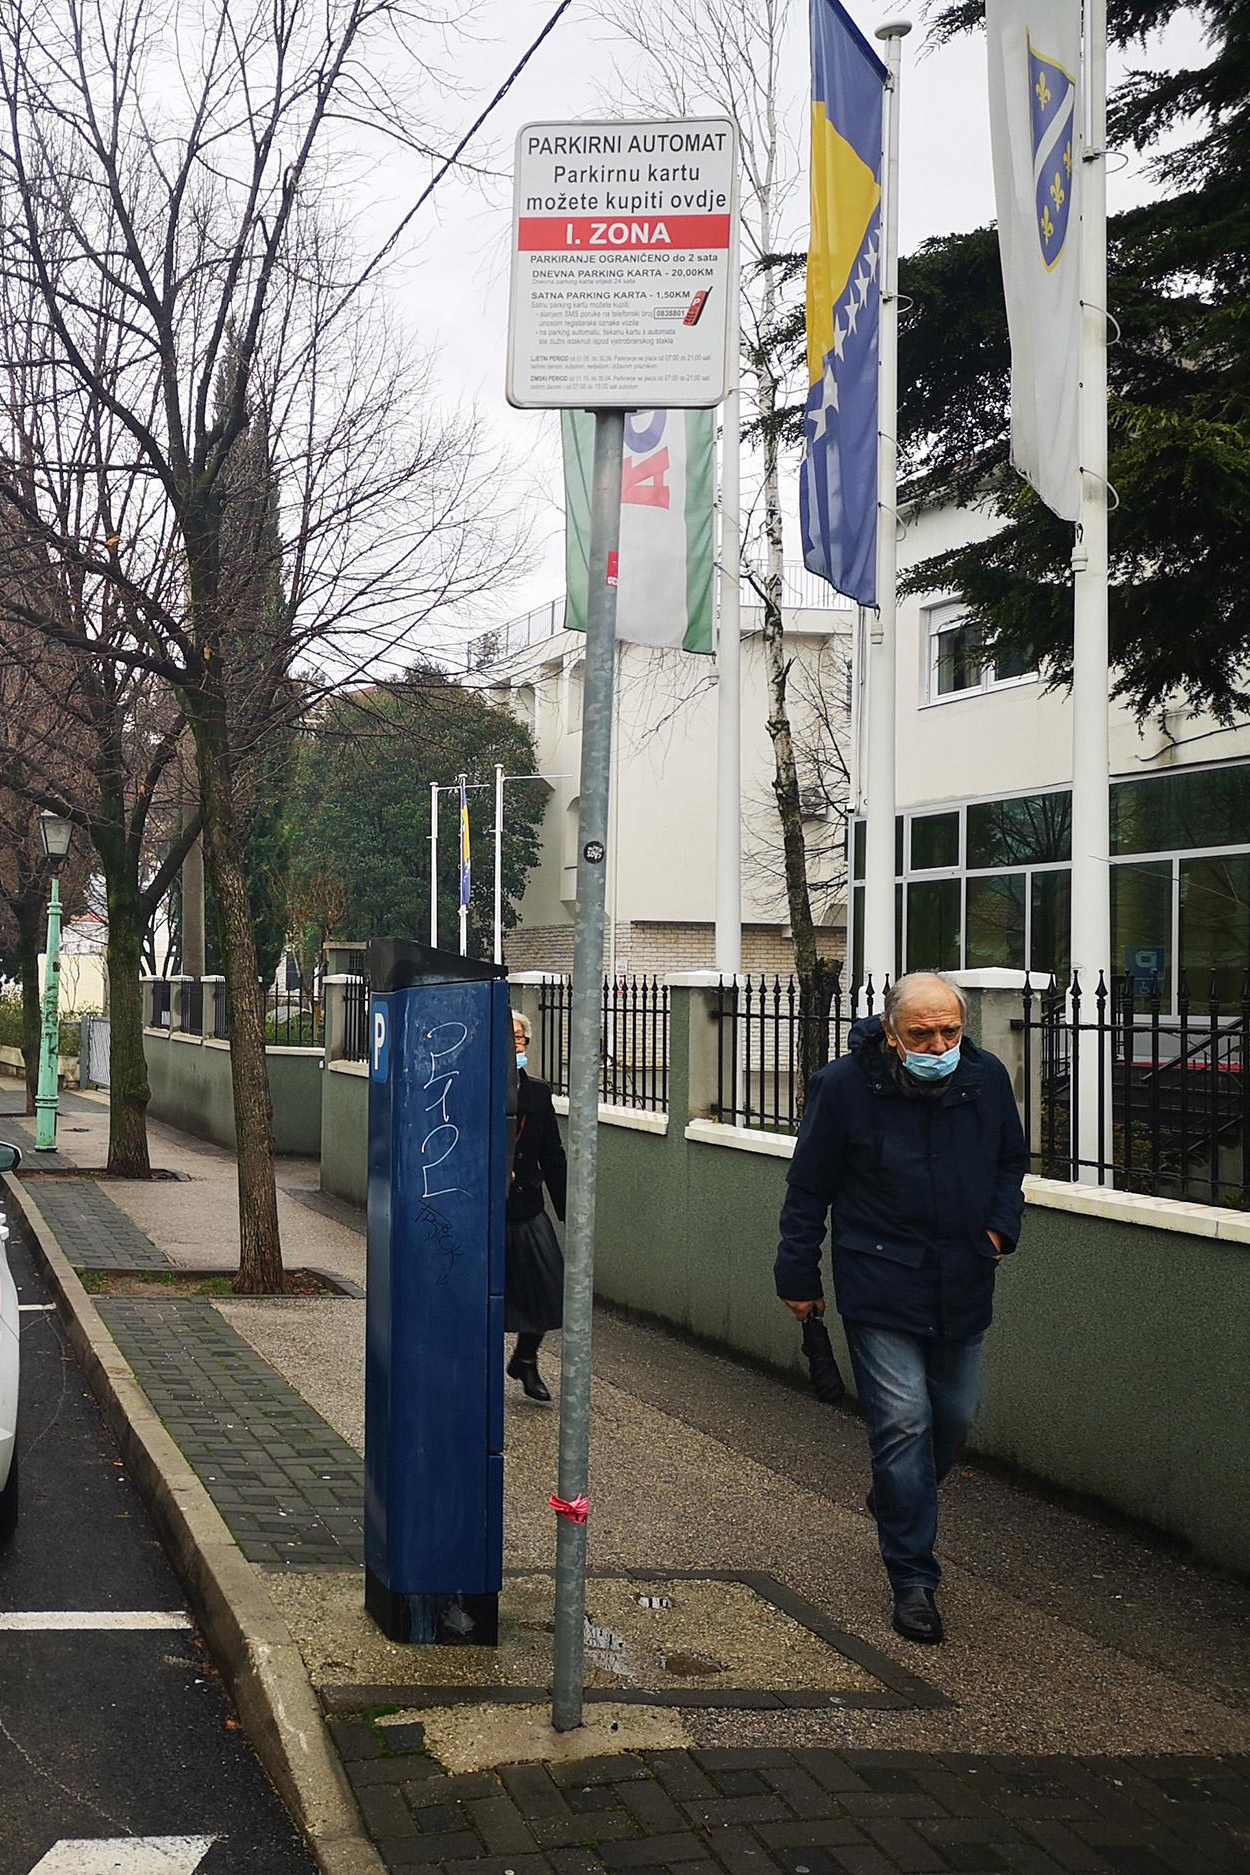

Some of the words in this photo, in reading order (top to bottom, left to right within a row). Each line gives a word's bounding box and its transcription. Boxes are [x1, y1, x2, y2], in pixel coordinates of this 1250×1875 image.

[528, 136, 621, 154] PARKIRNI
[628, 133, 727, 153] AUTOMAT
[554, 165, 640, 183] Parkirnu
[648, 164, 700, 182] kartu
[527, 193, 598, 210] možete
[606, 191, 663, 213] kupiti
[670, 190, 726, 212] ovdje
[566, 223, 581, 245] I.
[589, 222, 671, 244] ZONA
[530, 254, 596, 264] PARKIRANJE
[598, 253, 670, 264] OGRANIČENO
[672, 253, 686, 262] do
[689, 253, 696, 262] 2
[697, 254, 718, 262] sata
[532, 269, 575, 278] DNEVNA
[578, 269, 624, 278] PARKING
[627, 269, 662, 277] KARTA
[671, 268, 713, 277] 20,00KM
[531, 291, 564, 299] SATNA
[566, 291, 610, 299] PARKING
[614, 291, 647, 299] KARTA
[656, 291, 690, 299] 1,50KM
[374, 1012, 386, 1070] P
